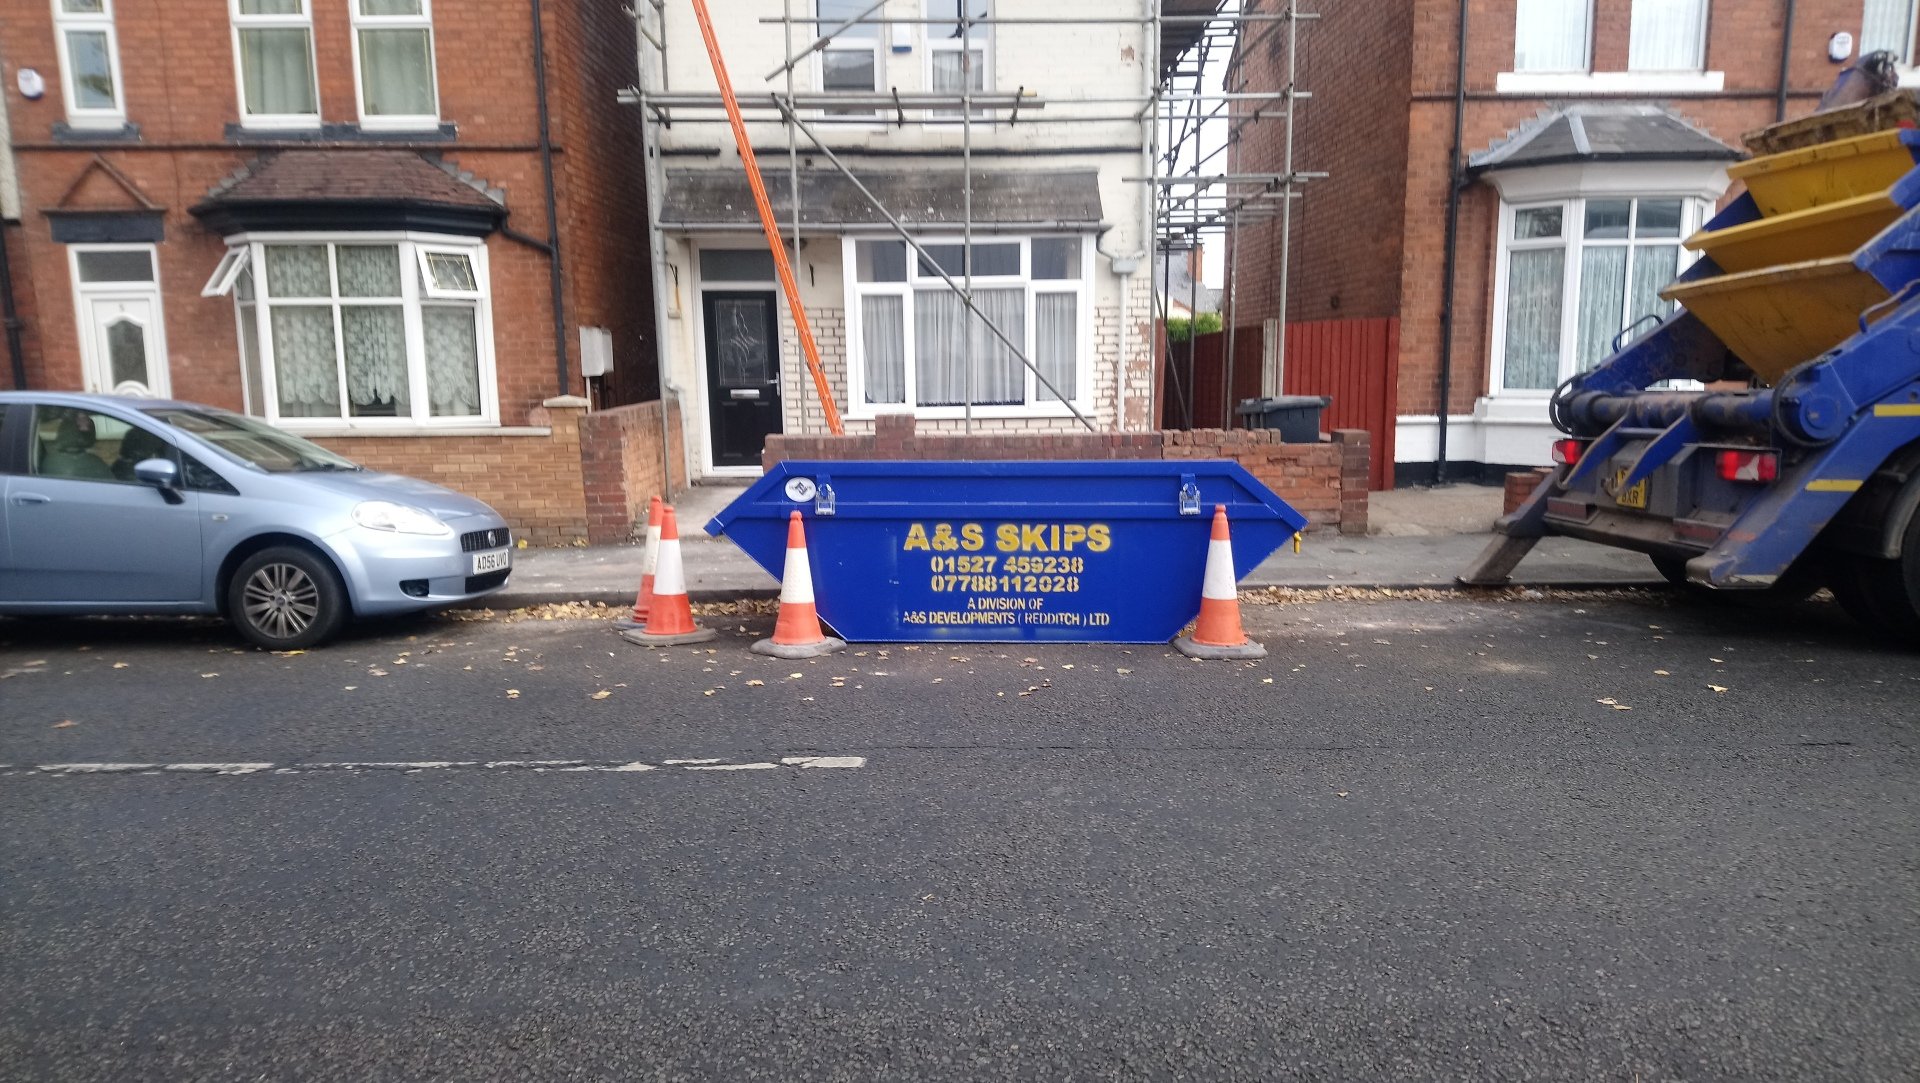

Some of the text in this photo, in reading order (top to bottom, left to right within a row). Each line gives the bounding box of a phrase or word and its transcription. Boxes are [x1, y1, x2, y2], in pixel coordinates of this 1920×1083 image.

[904, 523, 1111, 552] A&S SKIPS
[477, 555, 495, 570] AD56
[930, 556, 1084, 574] 01527 459238
[930, 575, 1080, 592] 07788112028
[967, 597, 1044, 610] A DIVISION OF
[903, 611, 927, 624] A&S
[929, 611, 1016, 625] DEVELOPMENTS
[1089, 613, 1110, 626] LTD
